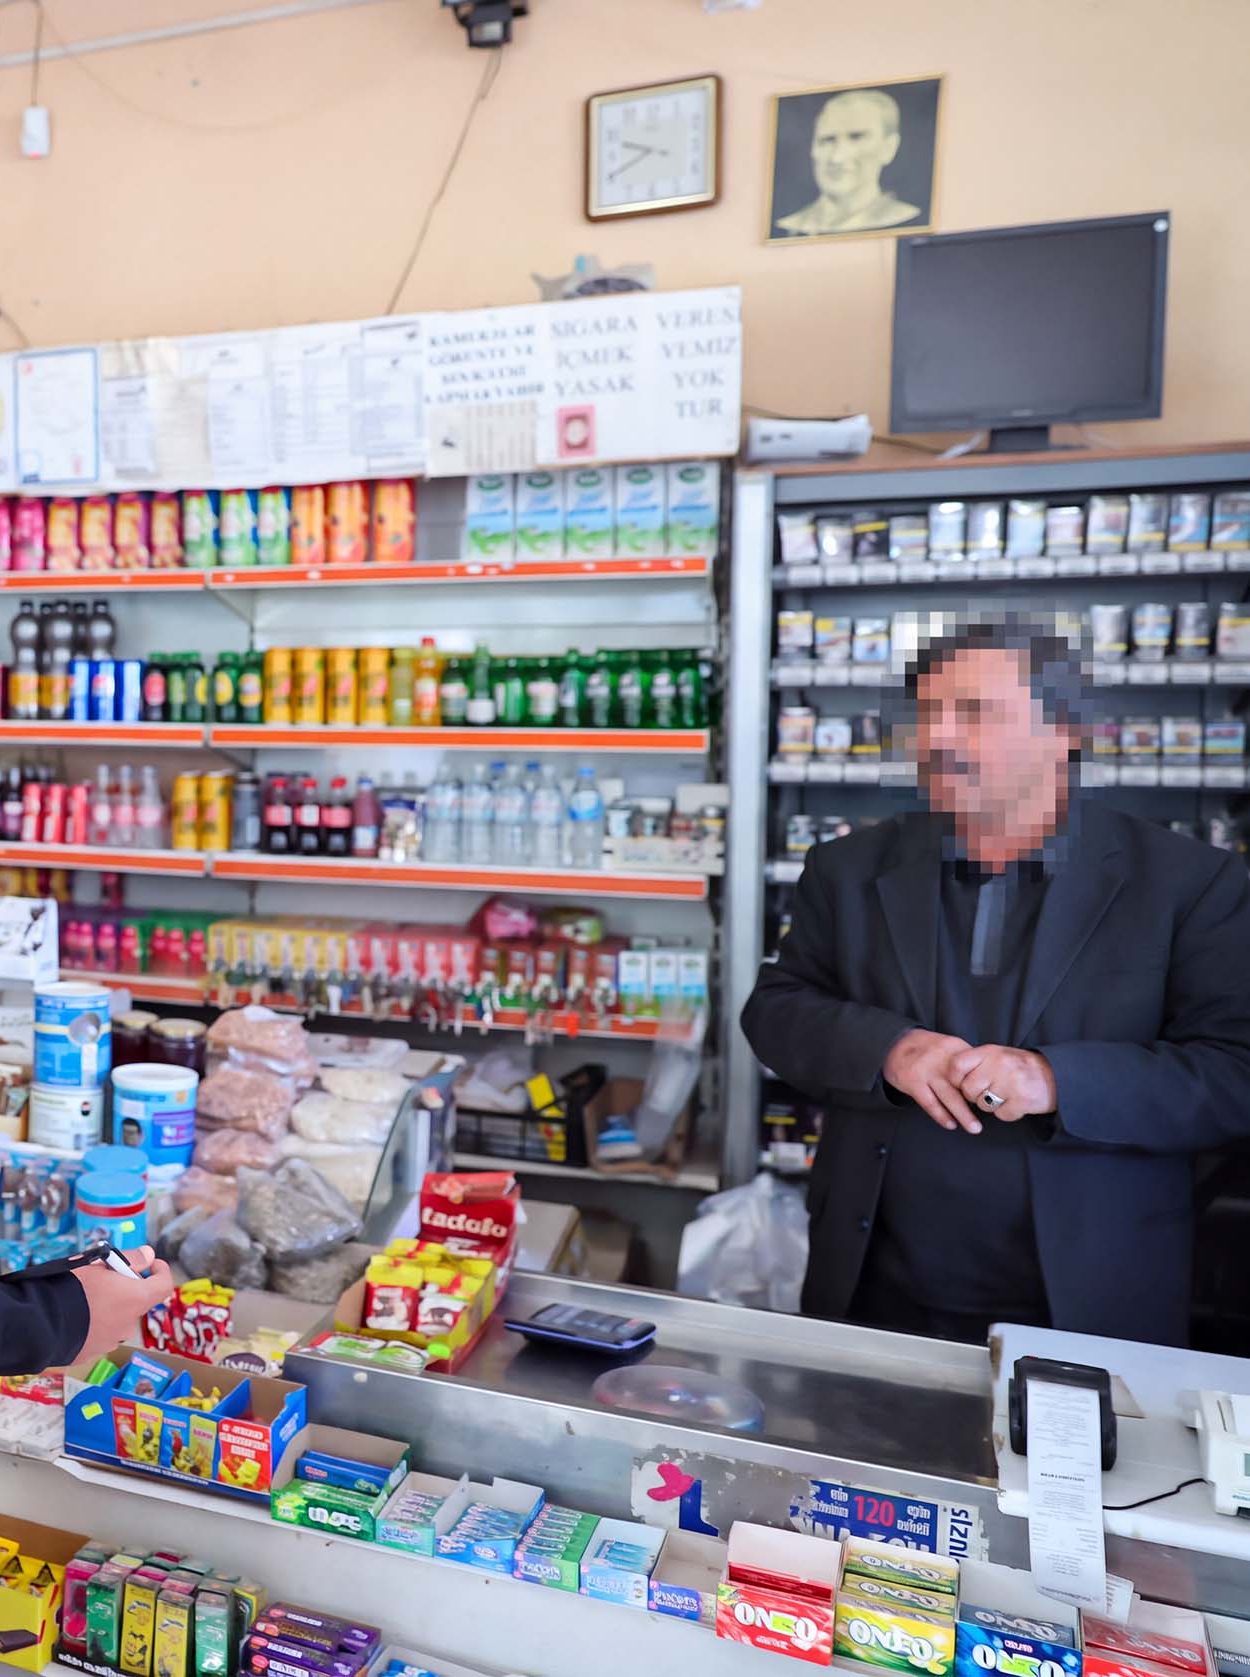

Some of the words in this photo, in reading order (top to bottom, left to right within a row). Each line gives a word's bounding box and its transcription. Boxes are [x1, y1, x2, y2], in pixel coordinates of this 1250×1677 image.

[672, 367, 724, 389] YOK
[854, 1495, 895, 1528] 120
[848, 1618, 936, 1663] ONEO
